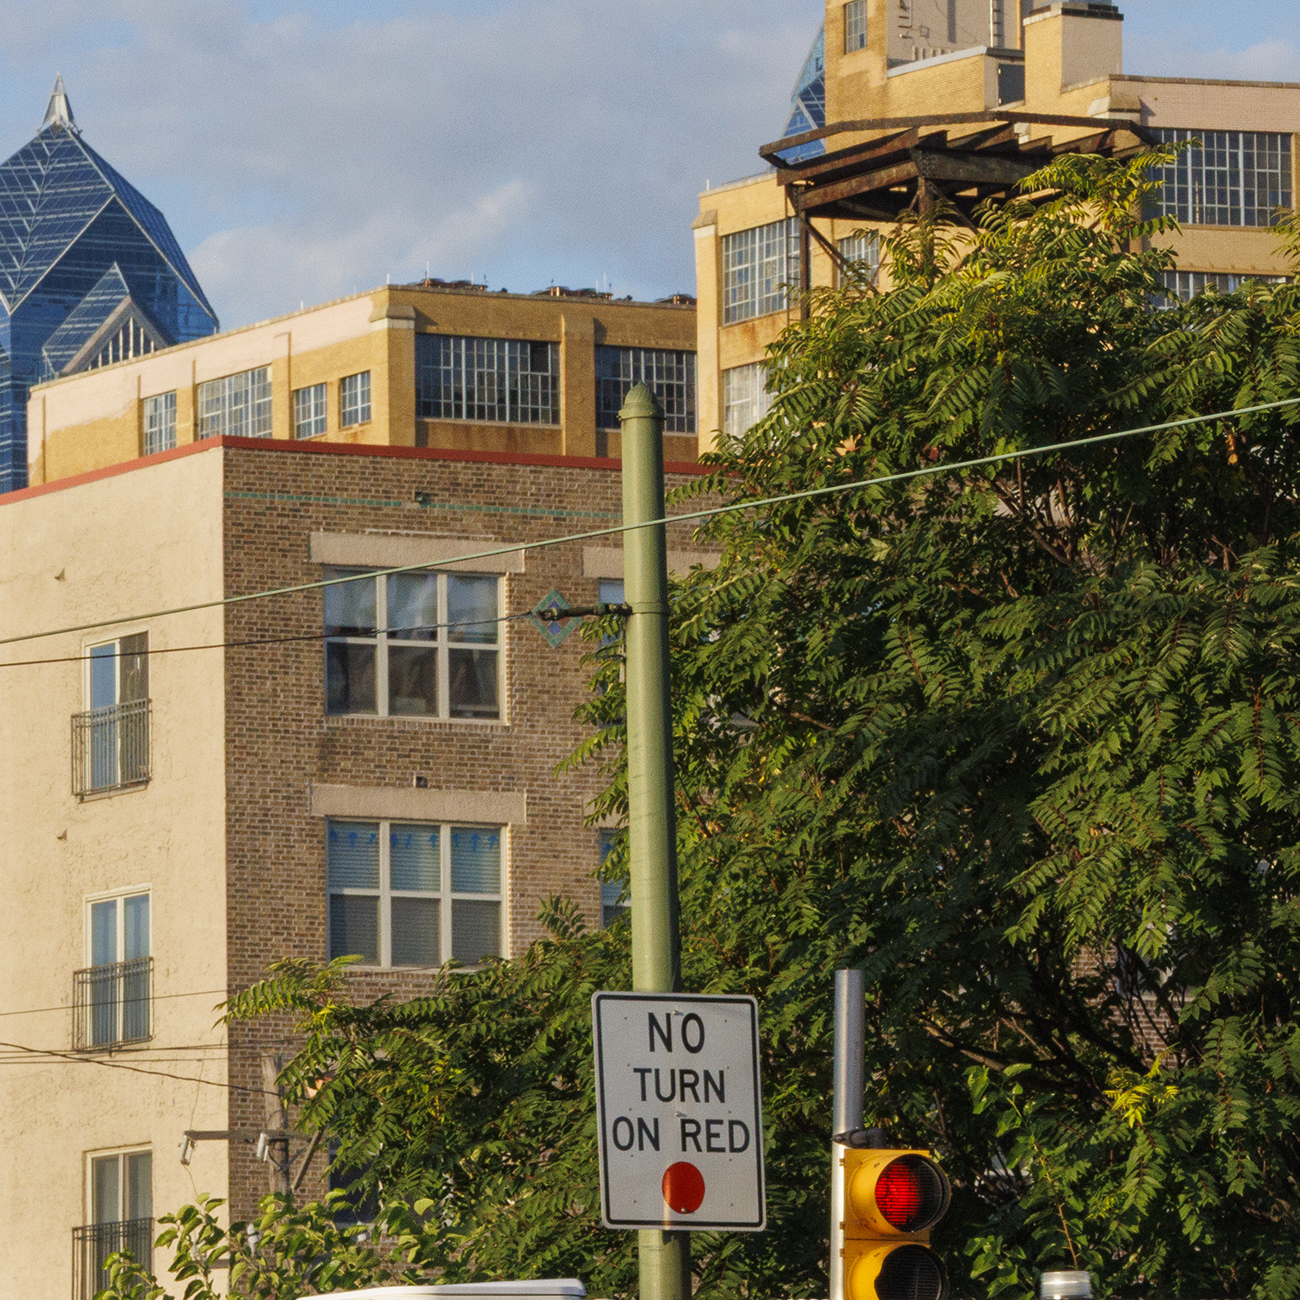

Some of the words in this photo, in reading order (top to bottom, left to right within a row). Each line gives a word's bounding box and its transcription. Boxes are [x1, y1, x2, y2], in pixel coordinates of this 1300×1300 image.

[648, 1012, 705, 1054] NO
[633, 1067, 726, 1104] TURN
[611, 1115, 660, 1152] ON
[681, 1119, 750, 1154] RED
